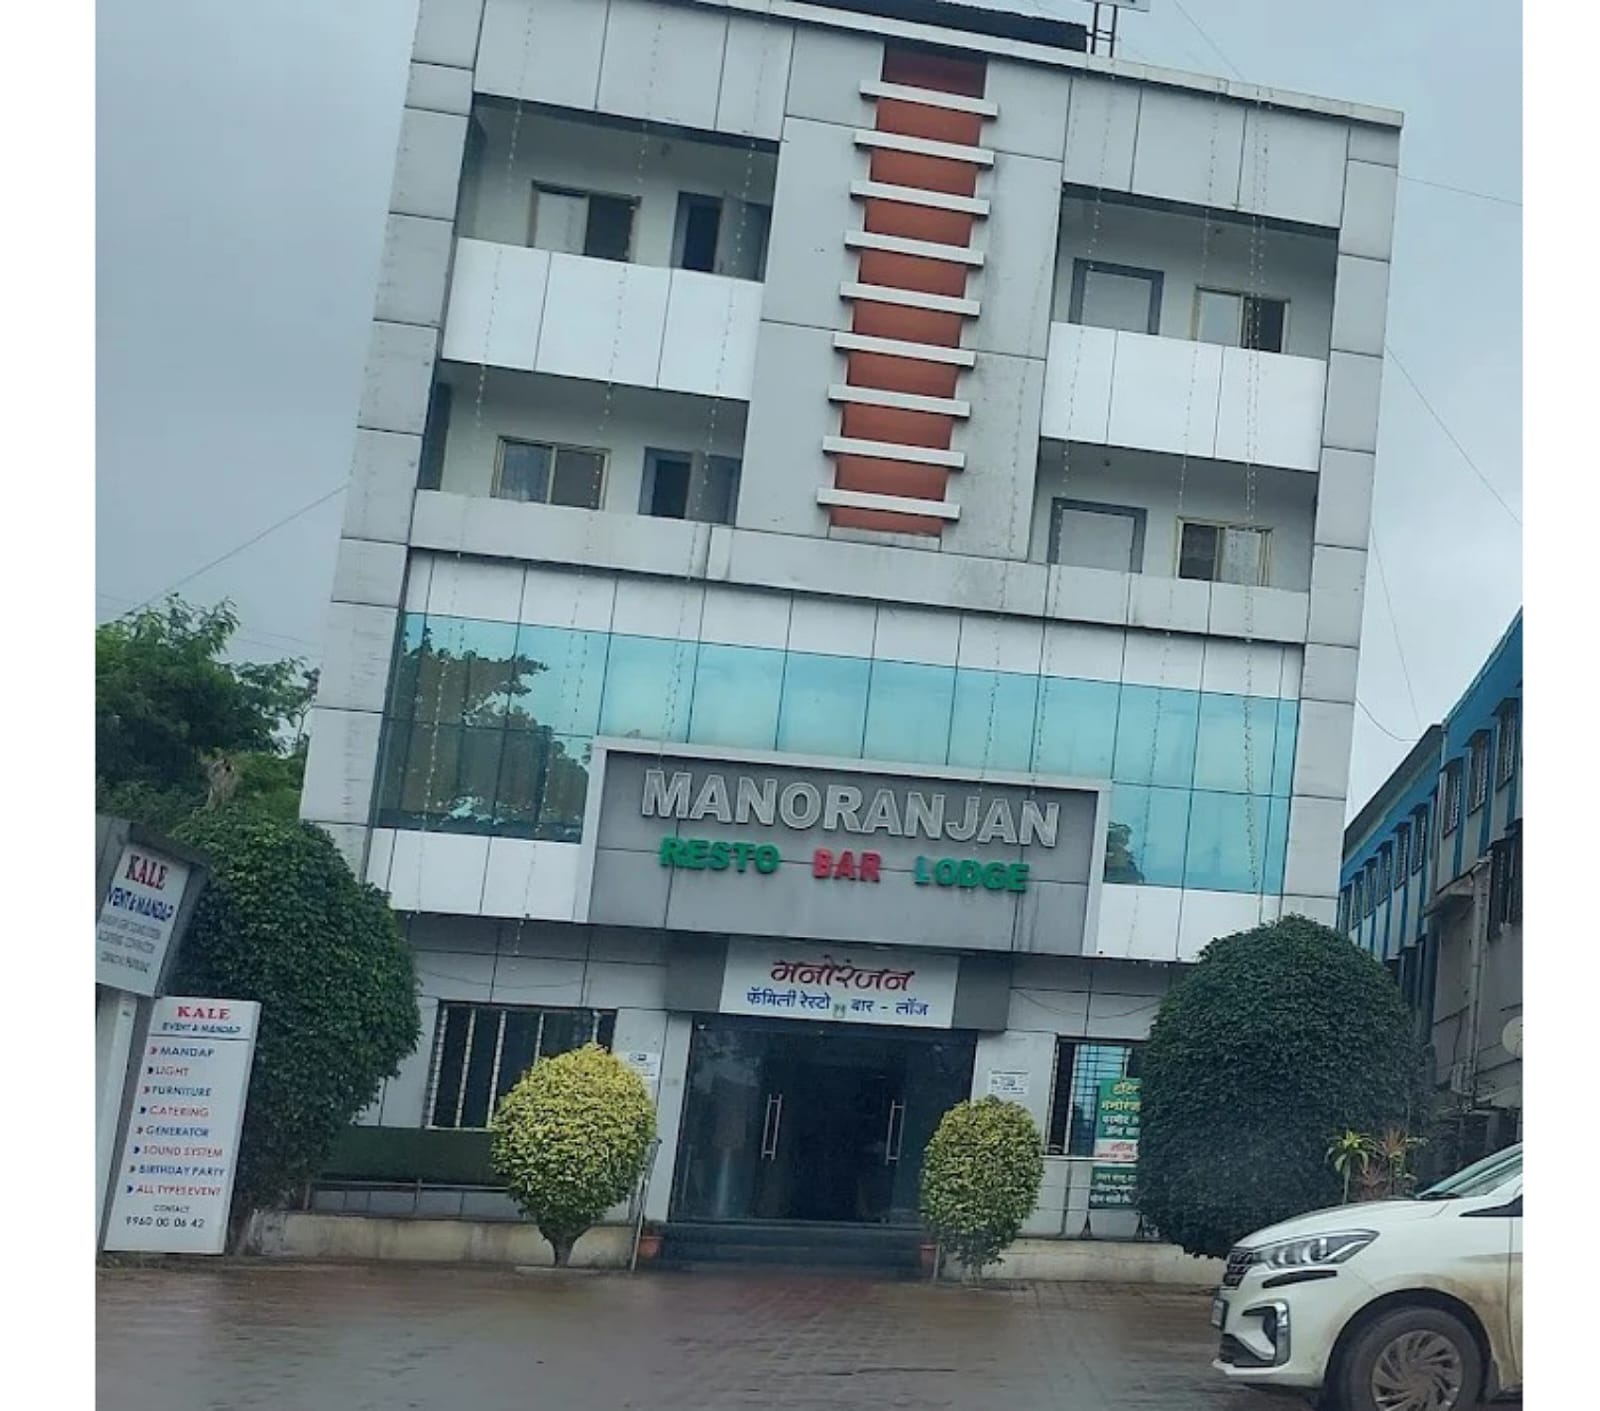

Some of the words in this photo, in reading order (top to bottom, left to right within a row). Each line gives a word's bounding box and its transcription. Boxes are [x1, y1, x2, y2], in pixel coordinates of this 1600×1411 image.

[641, 768, 1061, 848] MANORANJAN
[659, 836, 781, 874] RESTO
[812, 848, 881, 882] BAR
[915, 855, 1031, 893] LODGE
[126, 854, 168, 890] KALE
[771, 954, 915, 992] मनोरंजन
[799, 991, 832, 1010] रेस्टो
[851, 998, 875, 1013] बार
[895, 997, 929, 1016] लॉज
[176, 1006, 231, 1020] KALE
[159, 1046, 216, 1058] MANDAP
[155, 1066, 190, 1077] LIGHT
[152, 1085, 213, 1097] FURNITURE
[149, 1105, 209, 1117] CATERING
[145, 1125, 210, 1138] GENERATOR
[143, 1145, 181, 1156] SOUND
[183, 1147, 223, 1158] SYSTEM
[139, 1164, 191, 1176] BIRTHDAY
[192, 1166, 225, 1177] PARTY
[135, 1184, 155, 1195] ALL
